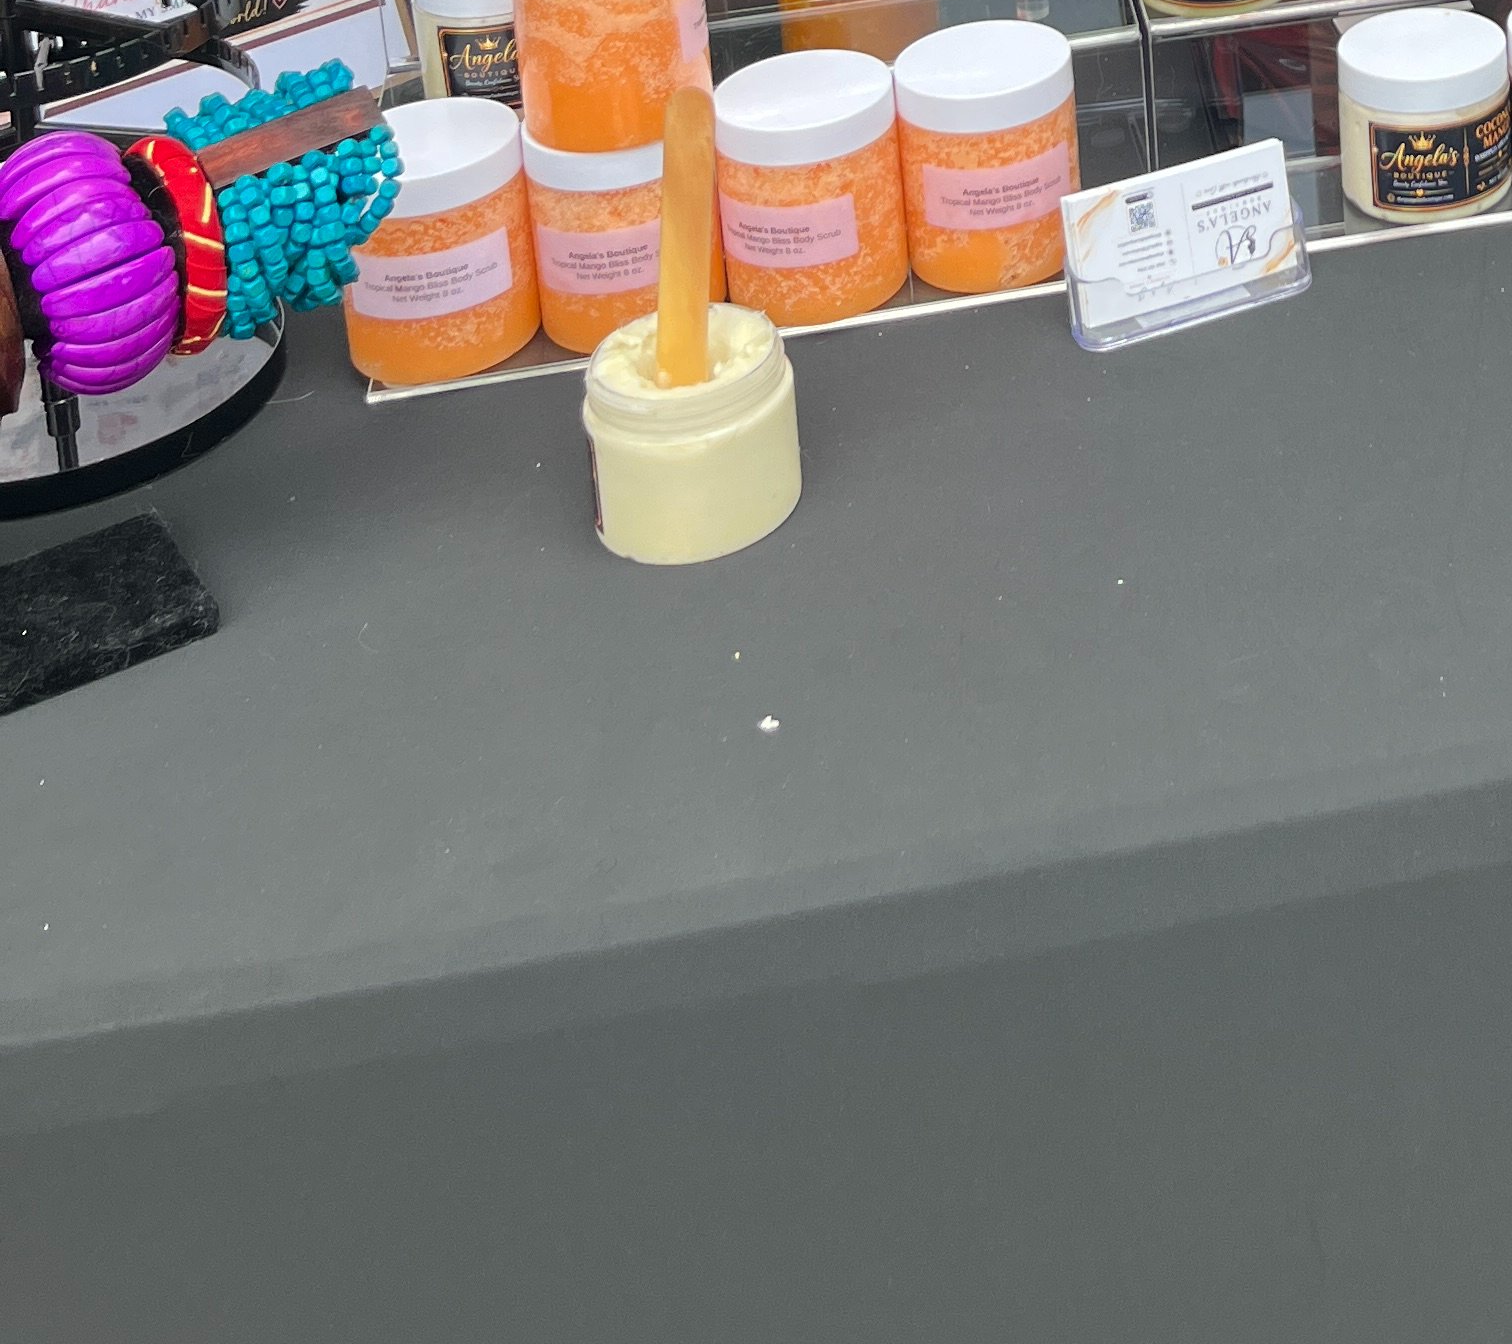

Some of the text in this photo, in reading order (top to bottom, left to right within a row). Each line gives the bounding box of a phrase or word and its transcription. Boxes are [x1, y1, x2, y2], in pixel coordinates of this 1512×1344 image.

[450, 39, 520, 73] Angel
[1381, 141, 1460, 172] Angela's
[1393, 170, 1449, 180] BOUTIQUE
[770, 226, 810, 235] Boutique
[568, 244, 648, 261] Angela's Boutique
[384, 263, 469, 284] Angela's Boutique
[395, 284, 425, 293] Mango
[450, 271, 474, 286] Body
